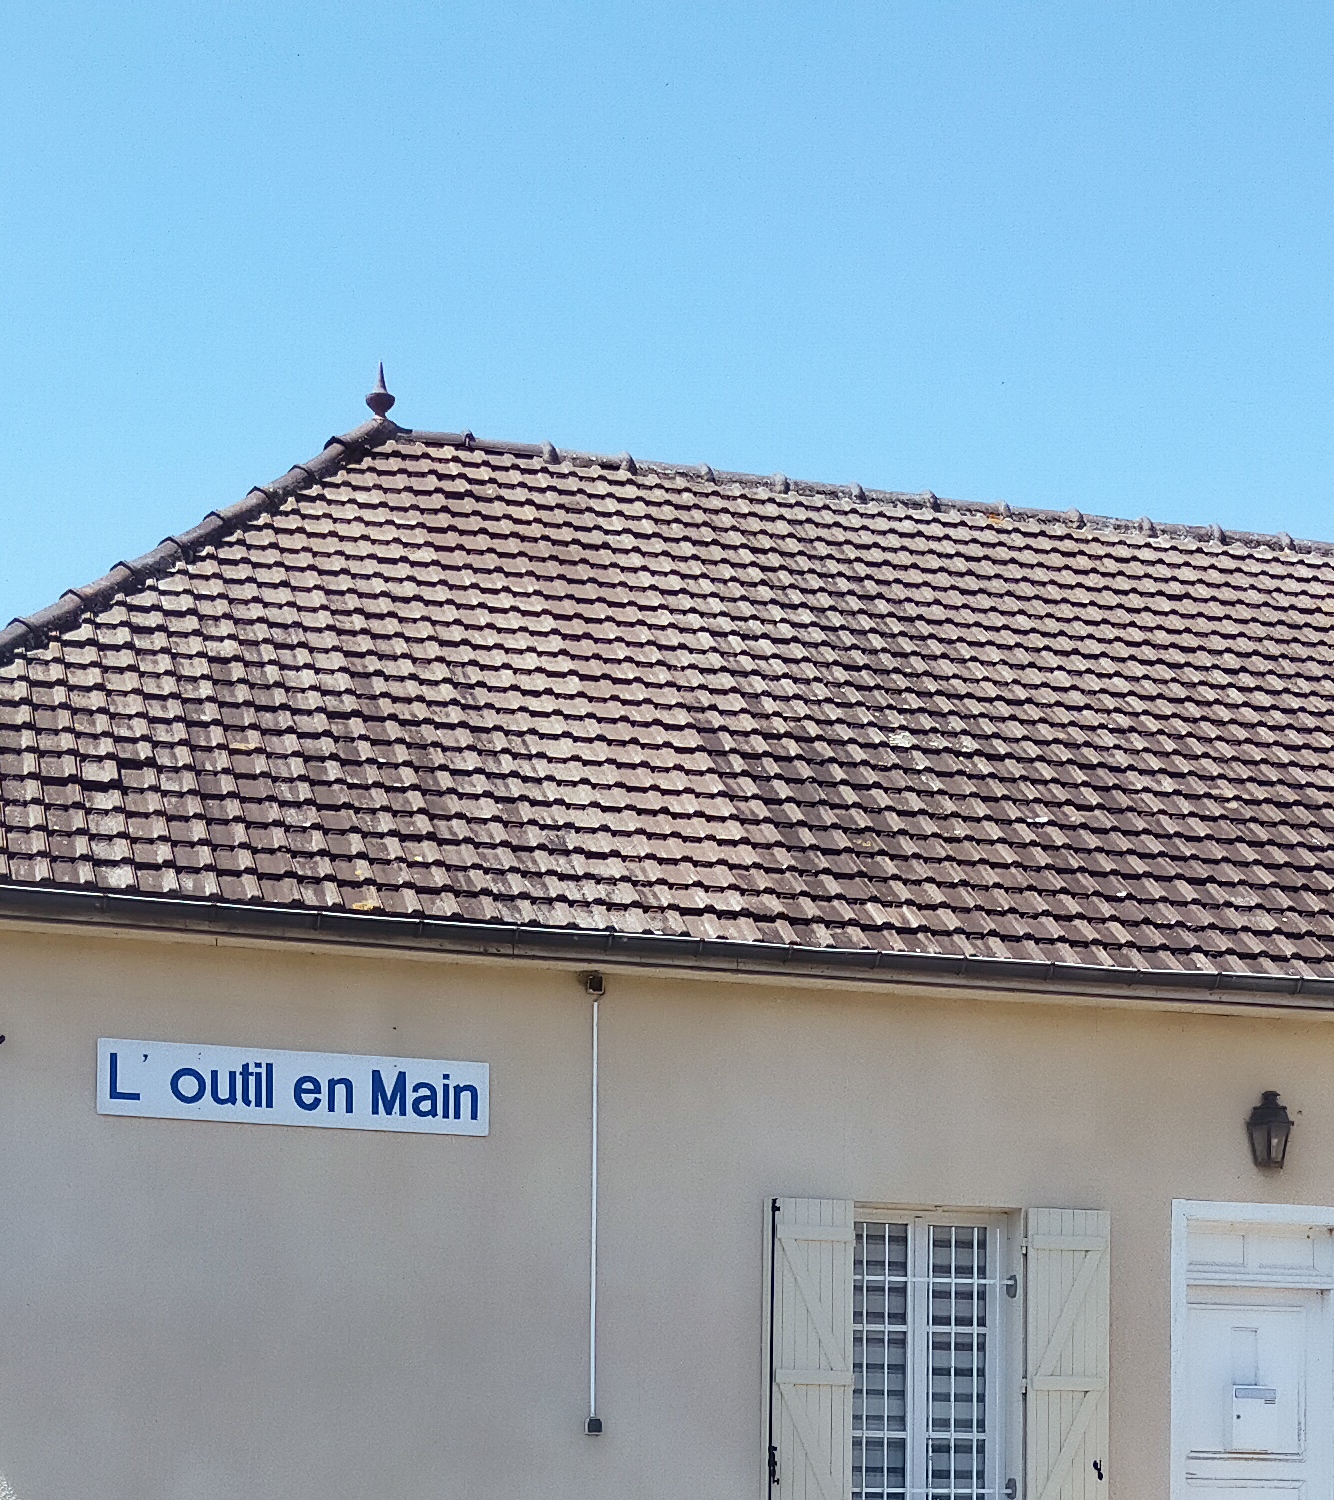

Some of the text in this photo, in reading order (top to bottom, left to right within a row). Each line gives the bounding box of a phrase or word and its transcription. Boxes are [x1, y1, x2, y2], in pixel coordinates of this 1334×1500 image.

[170, 1062, 274, 1109] outil
[293, 1074, 354, 1114] en
[371, 1069, 479, 1121] Main
